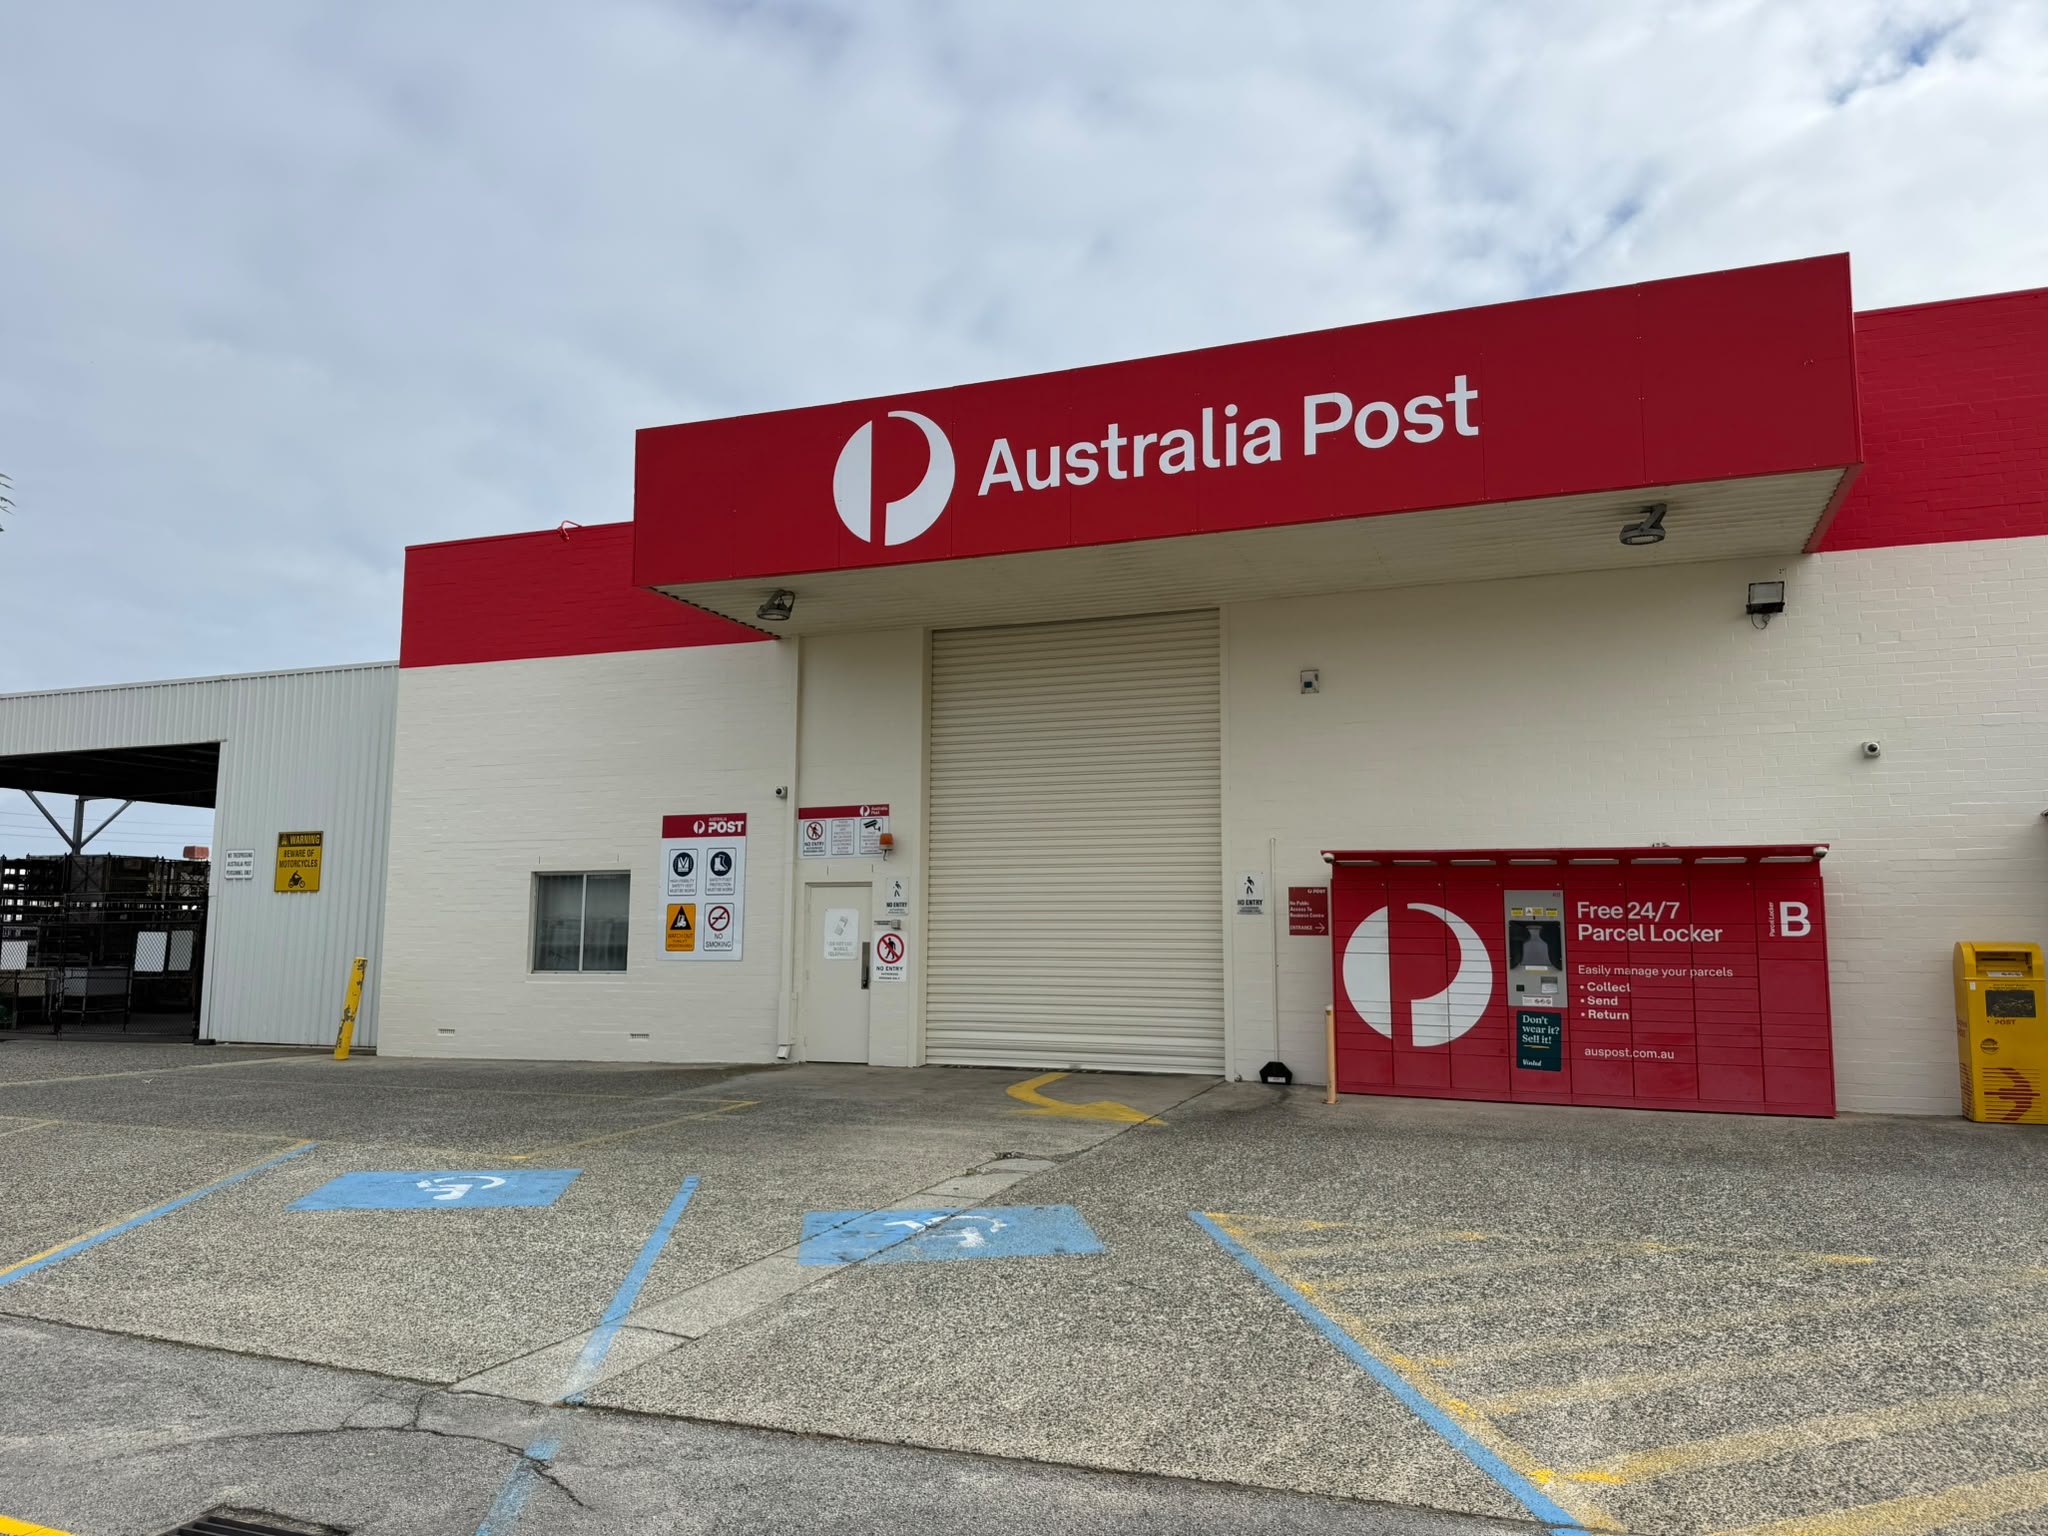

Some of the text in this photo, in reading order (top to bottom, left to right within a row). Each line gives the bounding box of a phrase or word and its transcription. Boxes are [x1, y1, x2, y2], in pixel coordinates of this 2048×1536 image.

[978, 375, 1480, 496] Australia Post
[708, 821, 744, 833] POST
[290, 834, 320, 845] WARNING
[284, 849, 315, 858] BEWARE OF
[280, 860, 319, 868] MOTORCYCLES
[1577, 901, 1680, 922] Free 24/7
[1780, 901, 1811, 937] B
[1578, 923, 1723, 942] Parcel Locker
[1578, 965, 1733, 978] Easily manage your parcels
[1587, 982, 1631, 992] Collect
[1587, 996, 1618, 1006] Send
[1522, 1014, 1548, 1024] Don't
[1588, 1010, 1629, 1020] Return
[1522, 1025, 1560, 1035] wear it?
[1522, 1034, 1552, 1044] Sell it!
[1584, 1048, 1674, 1059] auspost.com.au
